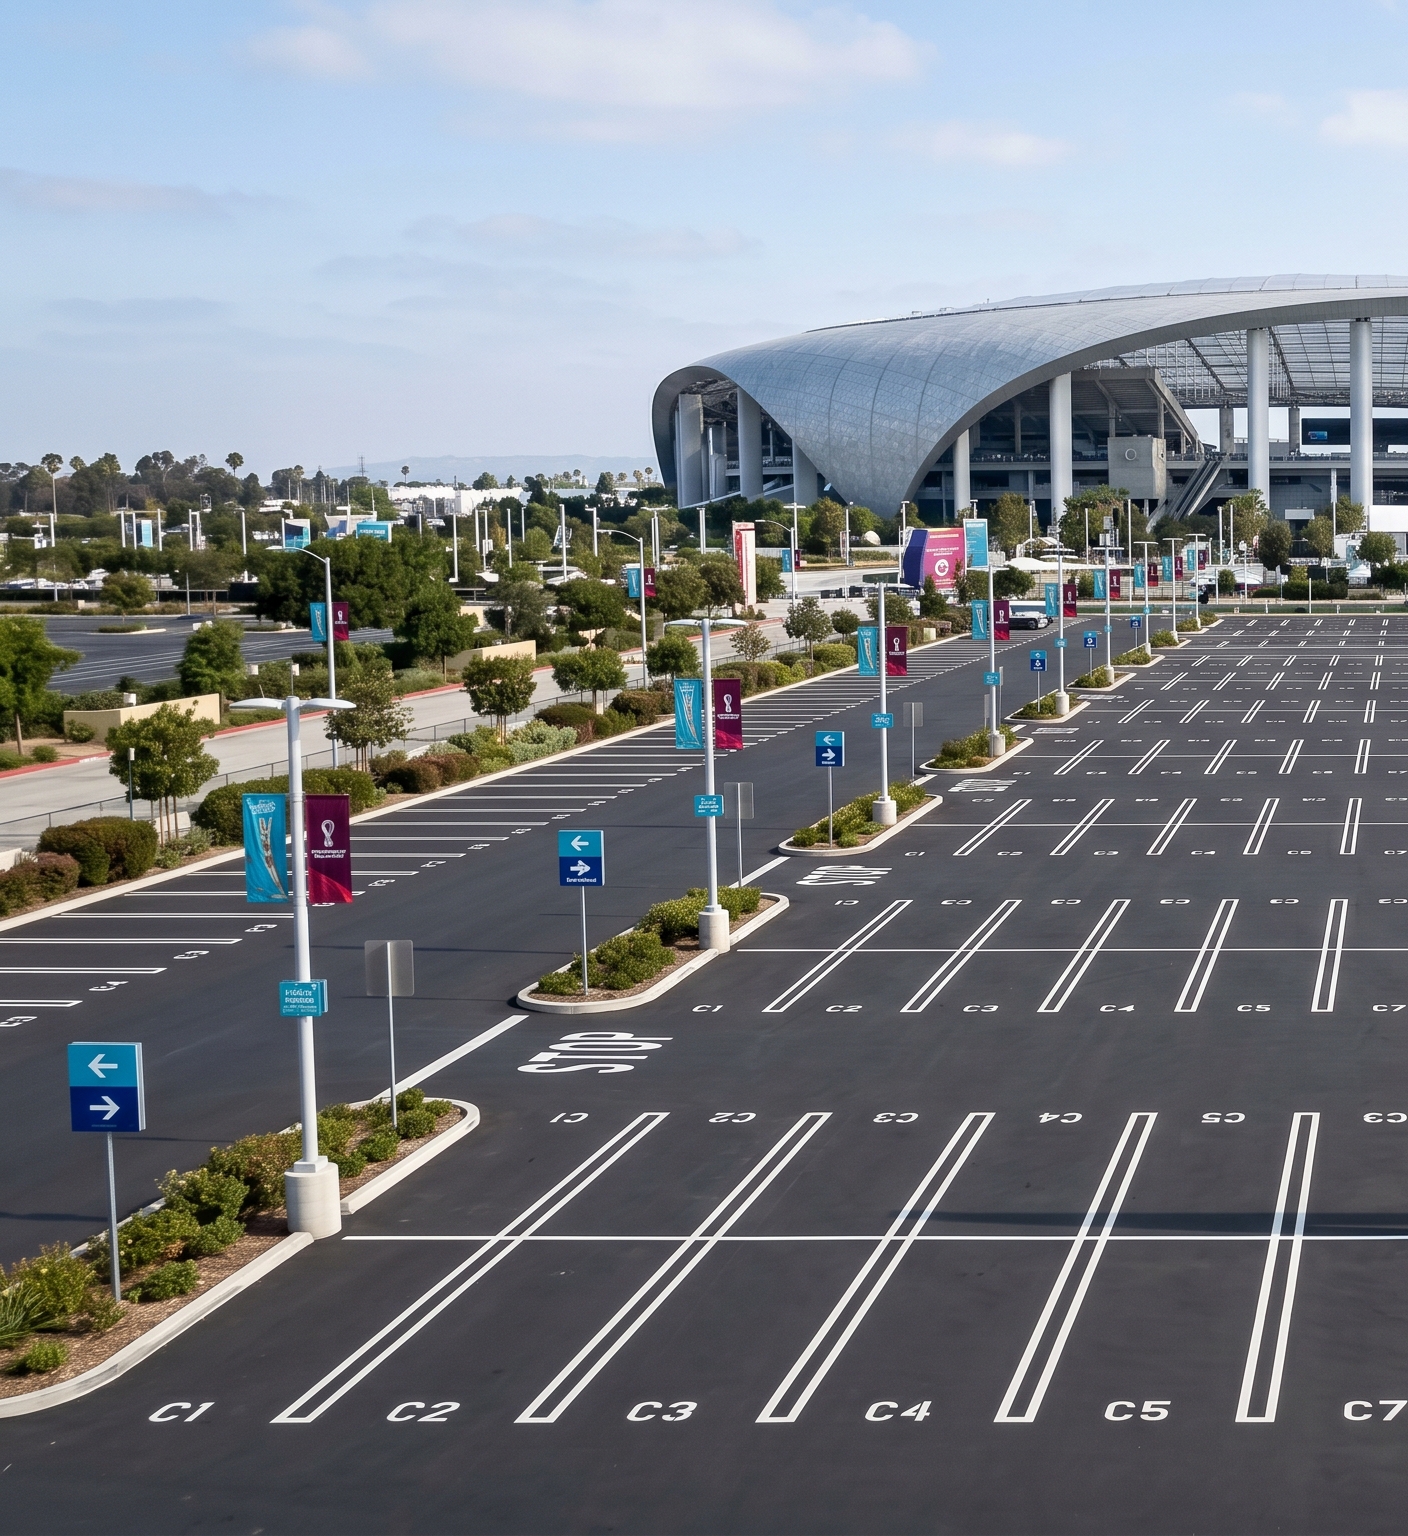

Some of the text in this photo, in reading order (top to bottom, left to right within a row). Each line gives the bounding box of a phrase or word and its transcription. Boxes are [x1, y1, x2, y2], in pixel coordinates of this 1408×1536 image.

[692, 1004, 724, 1013] C1
[825, 1004, 863, 1013] C2
[962, 1004, 999, 1013] C3
[1099, 1004, 1135, 1013] C4
[1236, 1004, 1271, 1012] C5
[1372, 1004, 1407, 1012] C7
[517, 1031, 674, 1074] STOP
[549, 1112, 589, 1123] C1
[708, 1112, 757, 1123] C2
[1038, 1112, 1083, 1124] C4
[1201, 1112, 1246, 1124] C5
[148, 1401, 215, 1423] C1
[386, 1401, 461, 1422] C2
[626, 1401, 698, 1422] C3
[864, 1400, 932, 1422] C4
[1104, 1400, 1172, 1422] C5
[1343, 1399, 1408, 1421] C7
